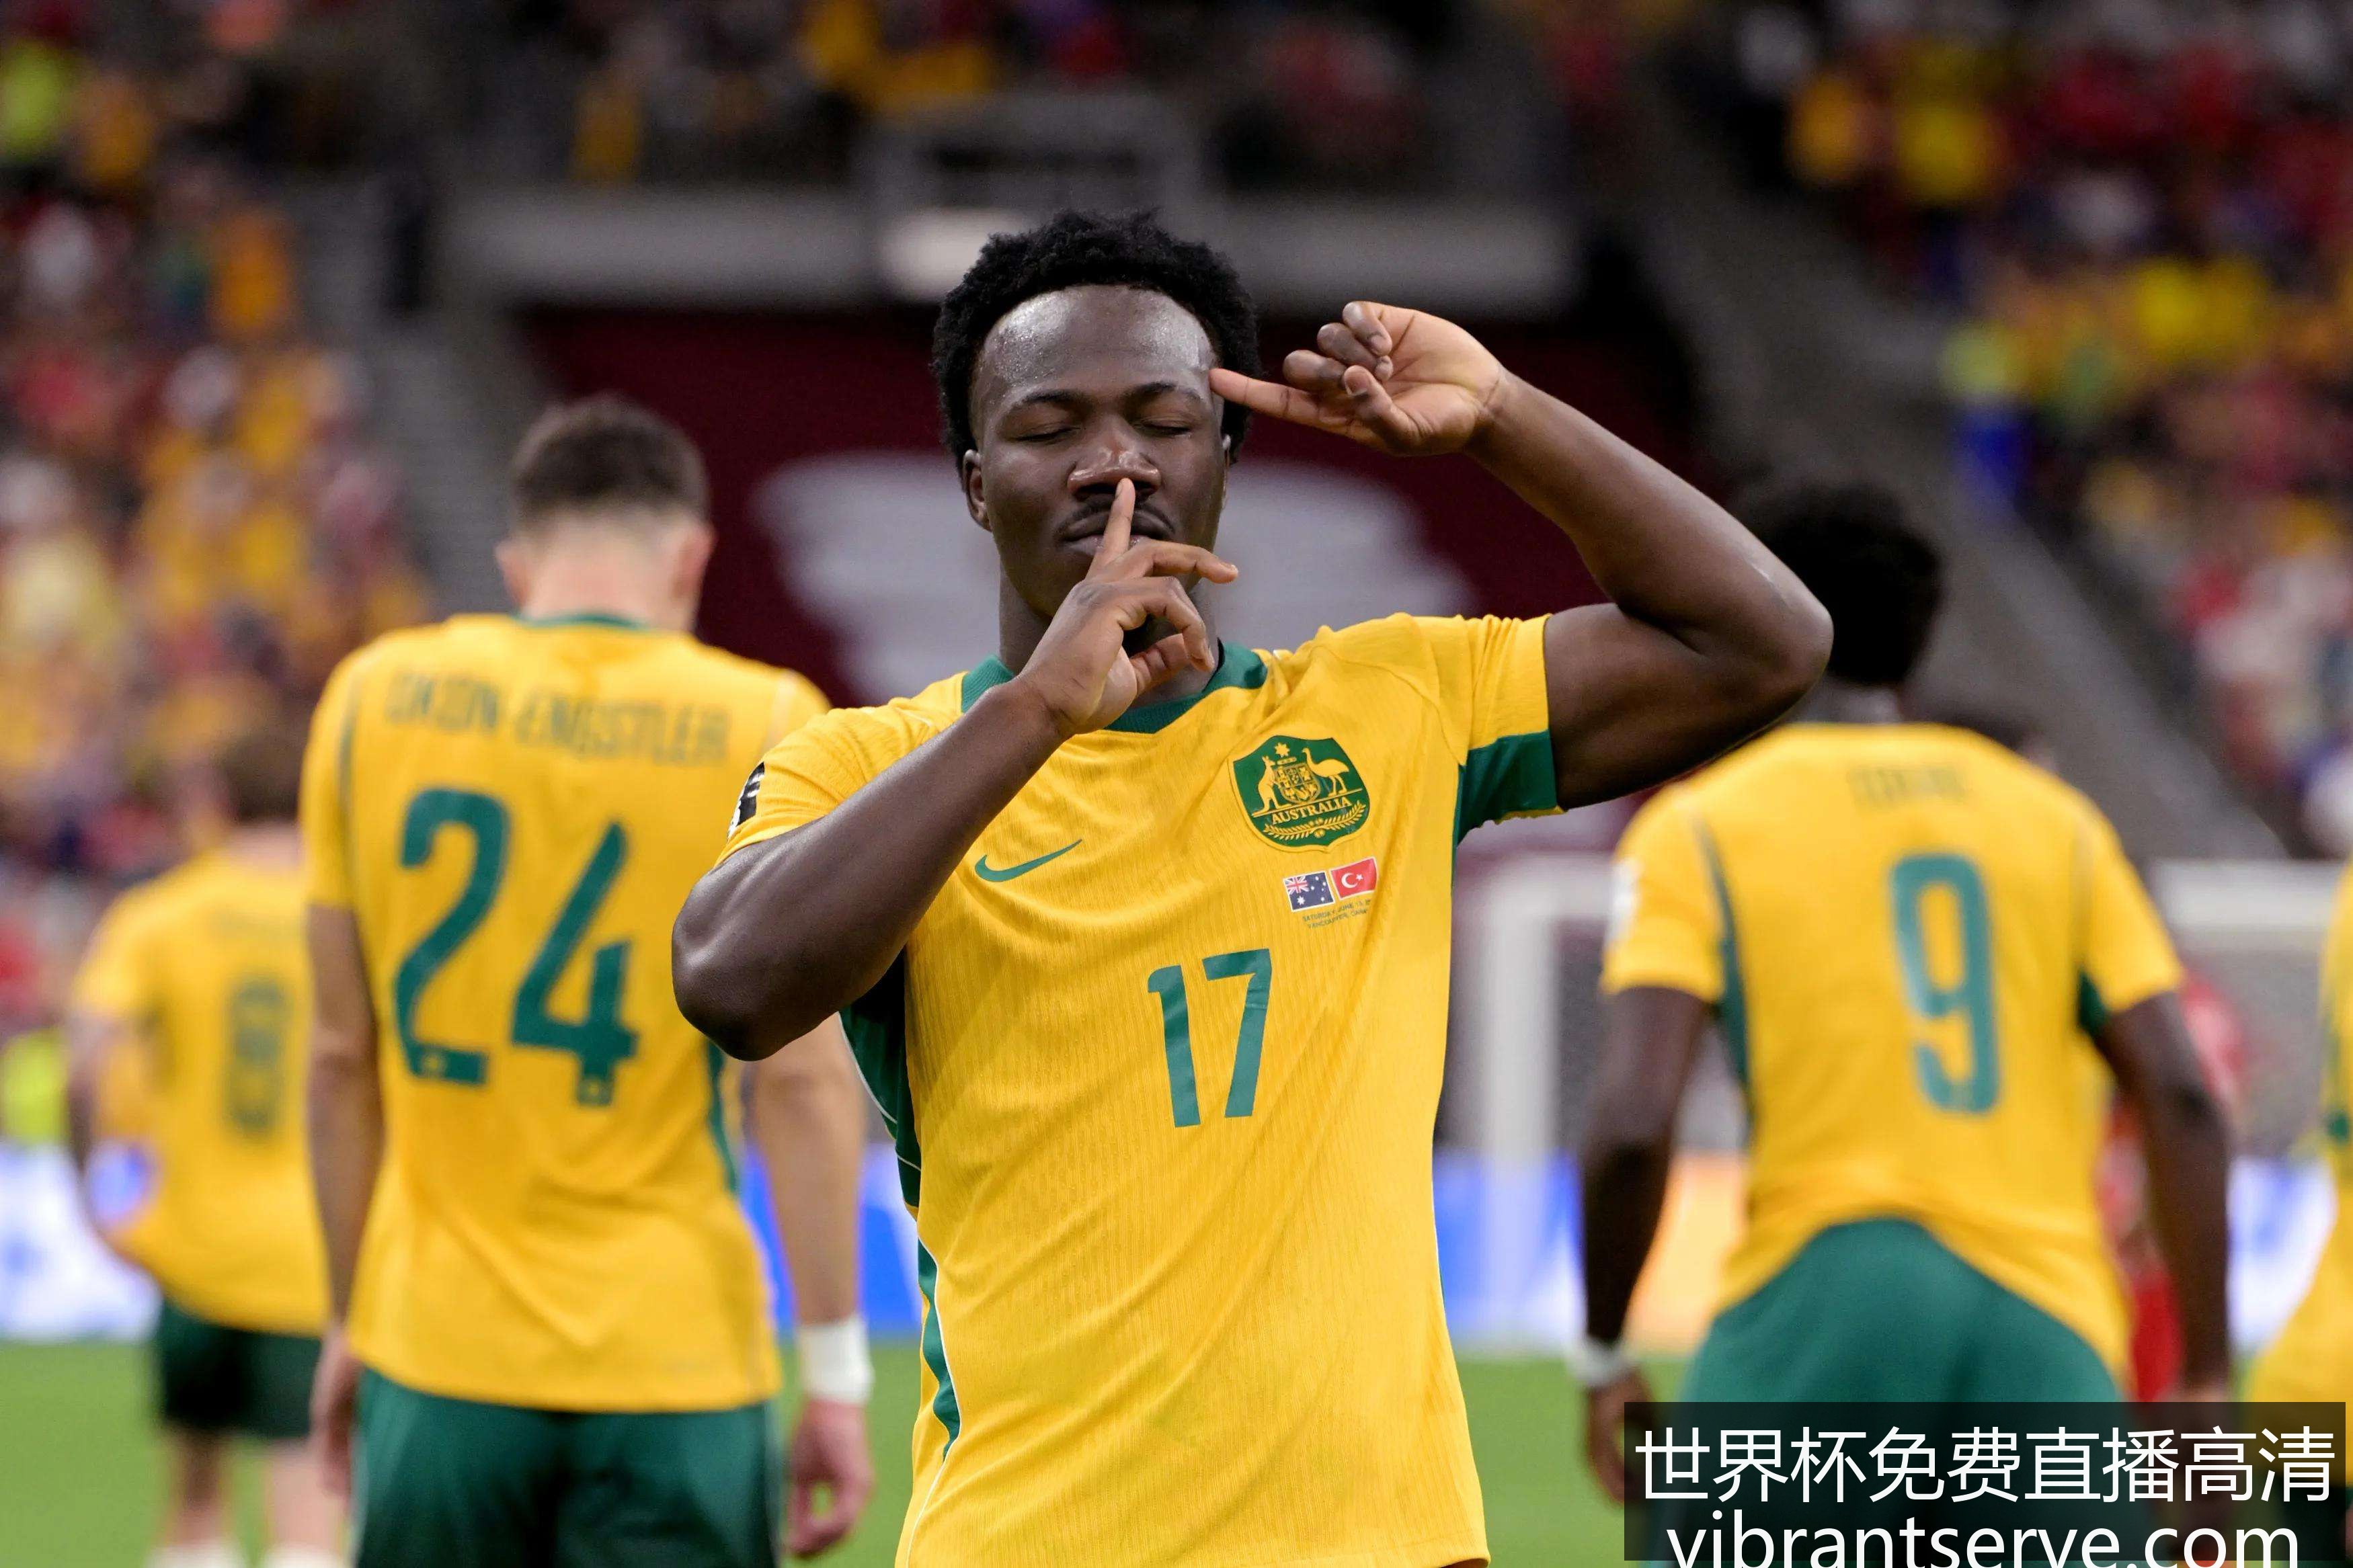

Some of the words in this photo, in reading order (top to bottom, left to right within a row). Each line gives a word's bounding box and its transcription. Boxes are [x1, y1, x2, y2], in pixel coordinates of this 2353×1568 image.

[1272, 797, 1351, 825] AUSTRALIA
[394, 787, 639, 1108] 24
[1148, 948, 1272, 1128] 17
[1890, 852, 1999, 1114] 9
